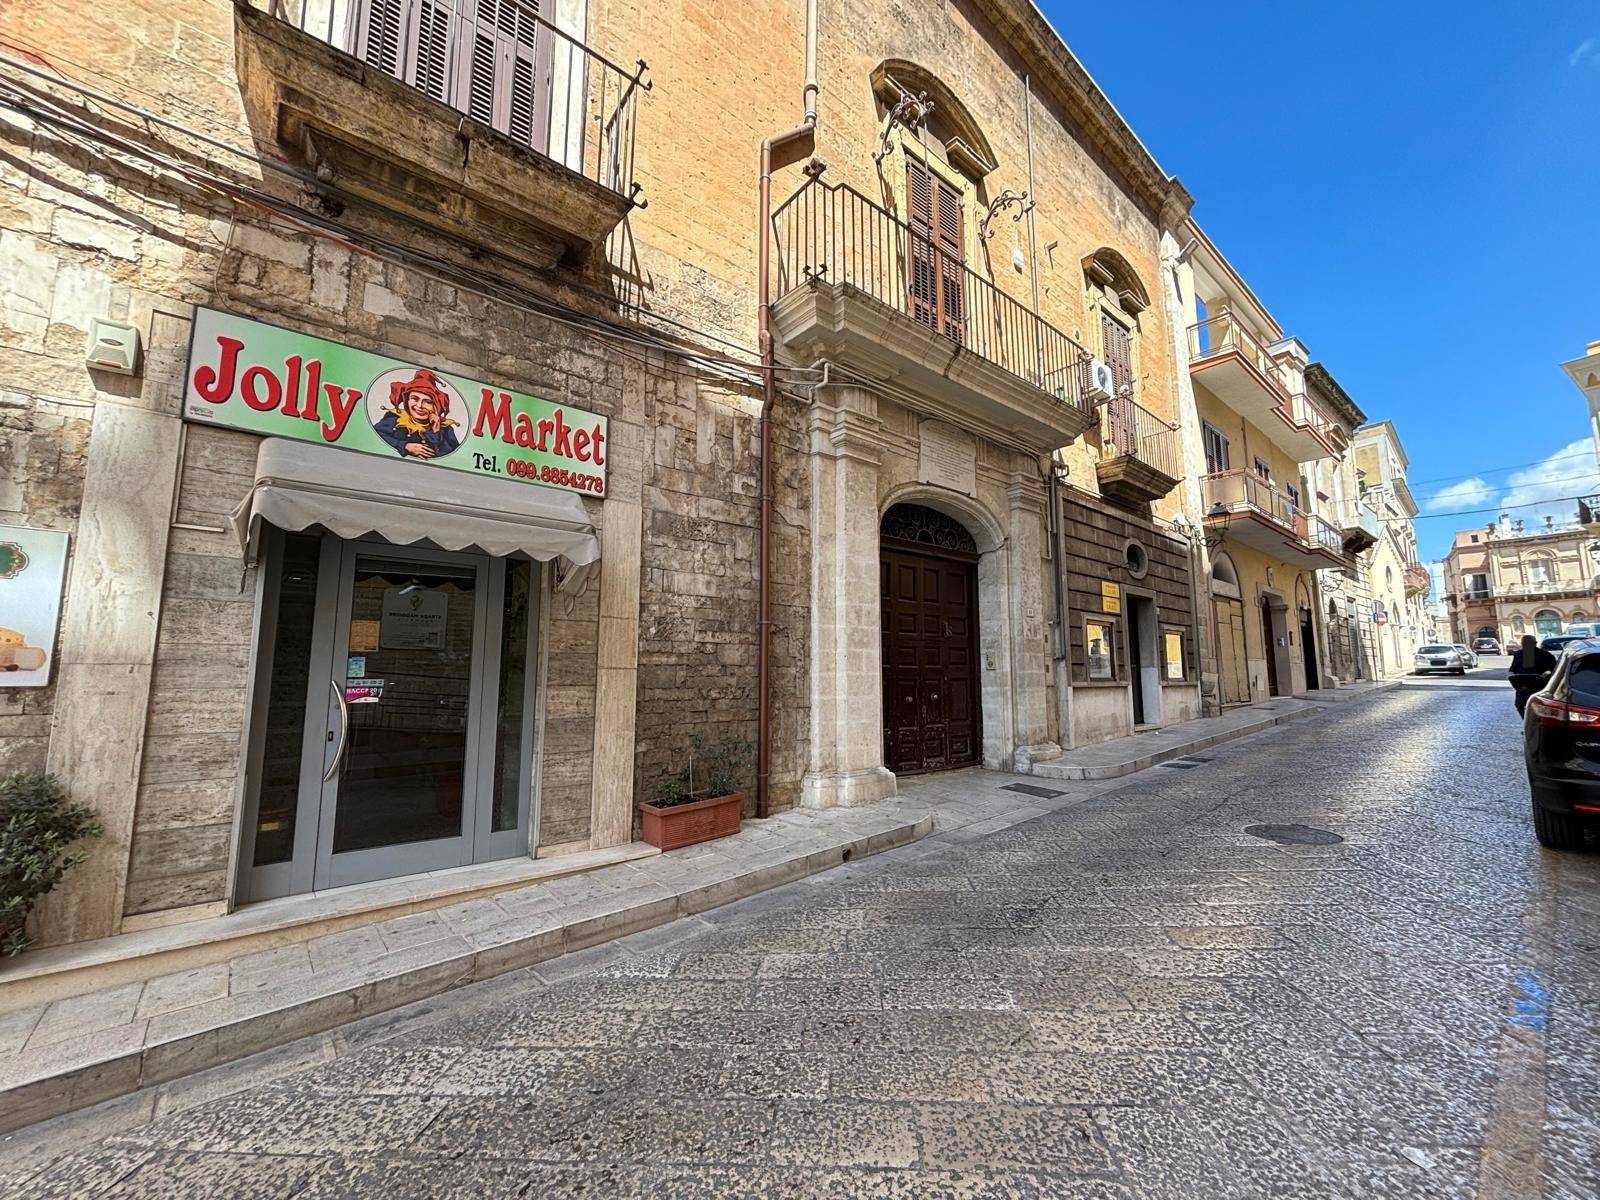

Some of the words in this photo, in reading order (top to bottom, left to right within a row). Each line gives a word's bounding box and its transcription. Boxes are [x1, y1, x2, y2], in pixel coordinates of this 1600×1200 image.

[193, 336, 362, 441] Jolly
[472, 387, 606, 466] Market
[472, 452, 502, 474] Tel.
[505, 457, 605, 494] 099.8854278
